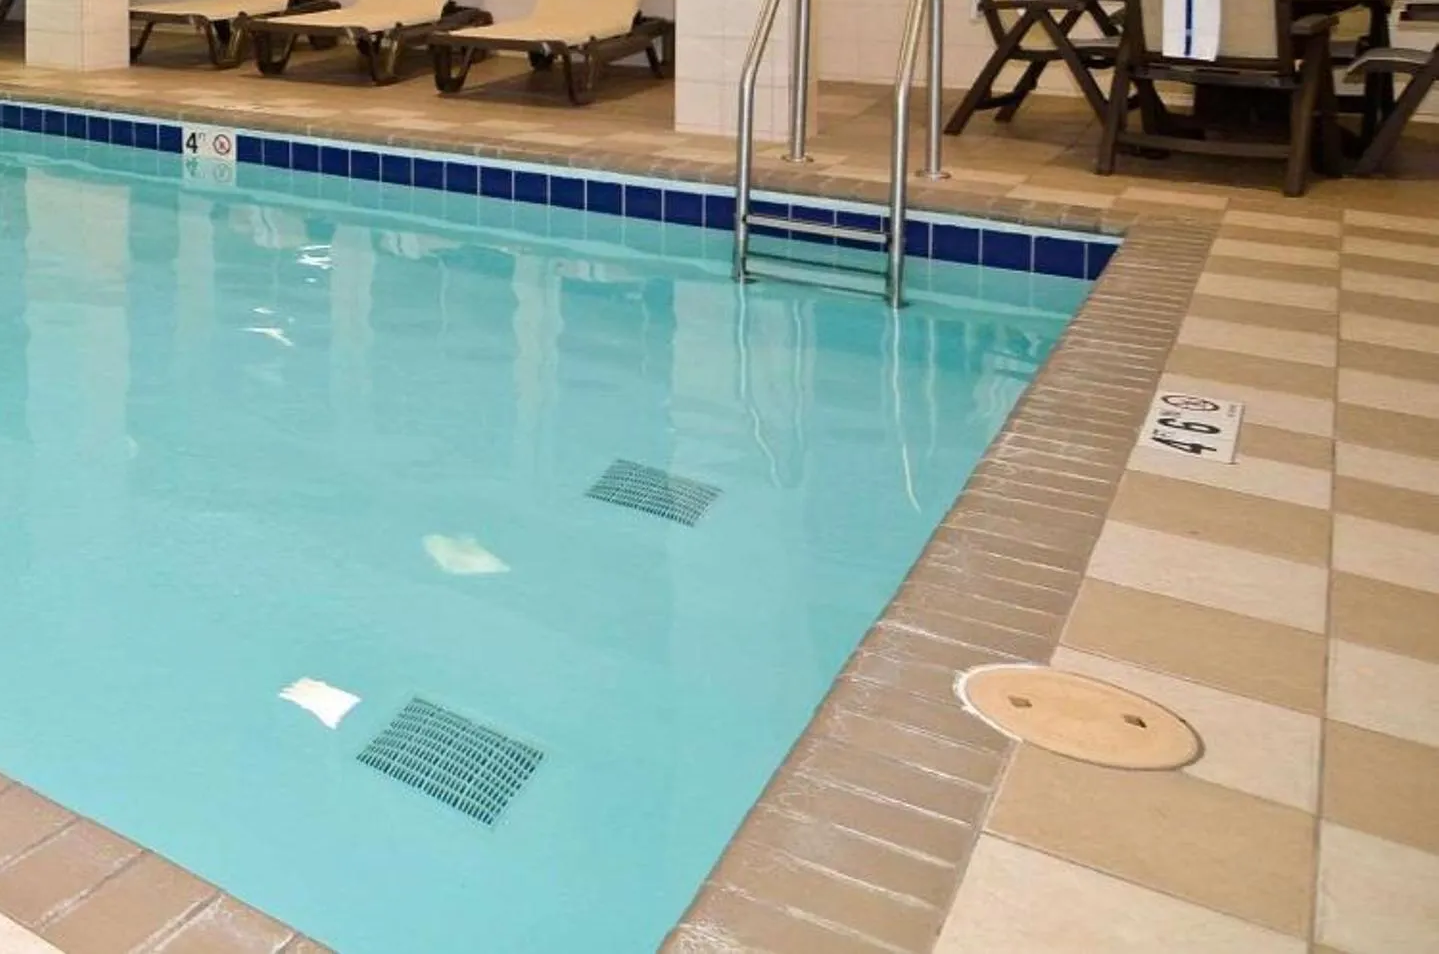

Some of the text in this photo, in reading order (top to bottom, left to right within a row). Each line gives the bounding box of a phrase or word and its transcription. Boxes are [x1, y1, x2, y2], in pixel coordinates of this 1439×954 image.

[186, 132, 198, 153] 4
[1151, 418, 1220, 454] 4 6
